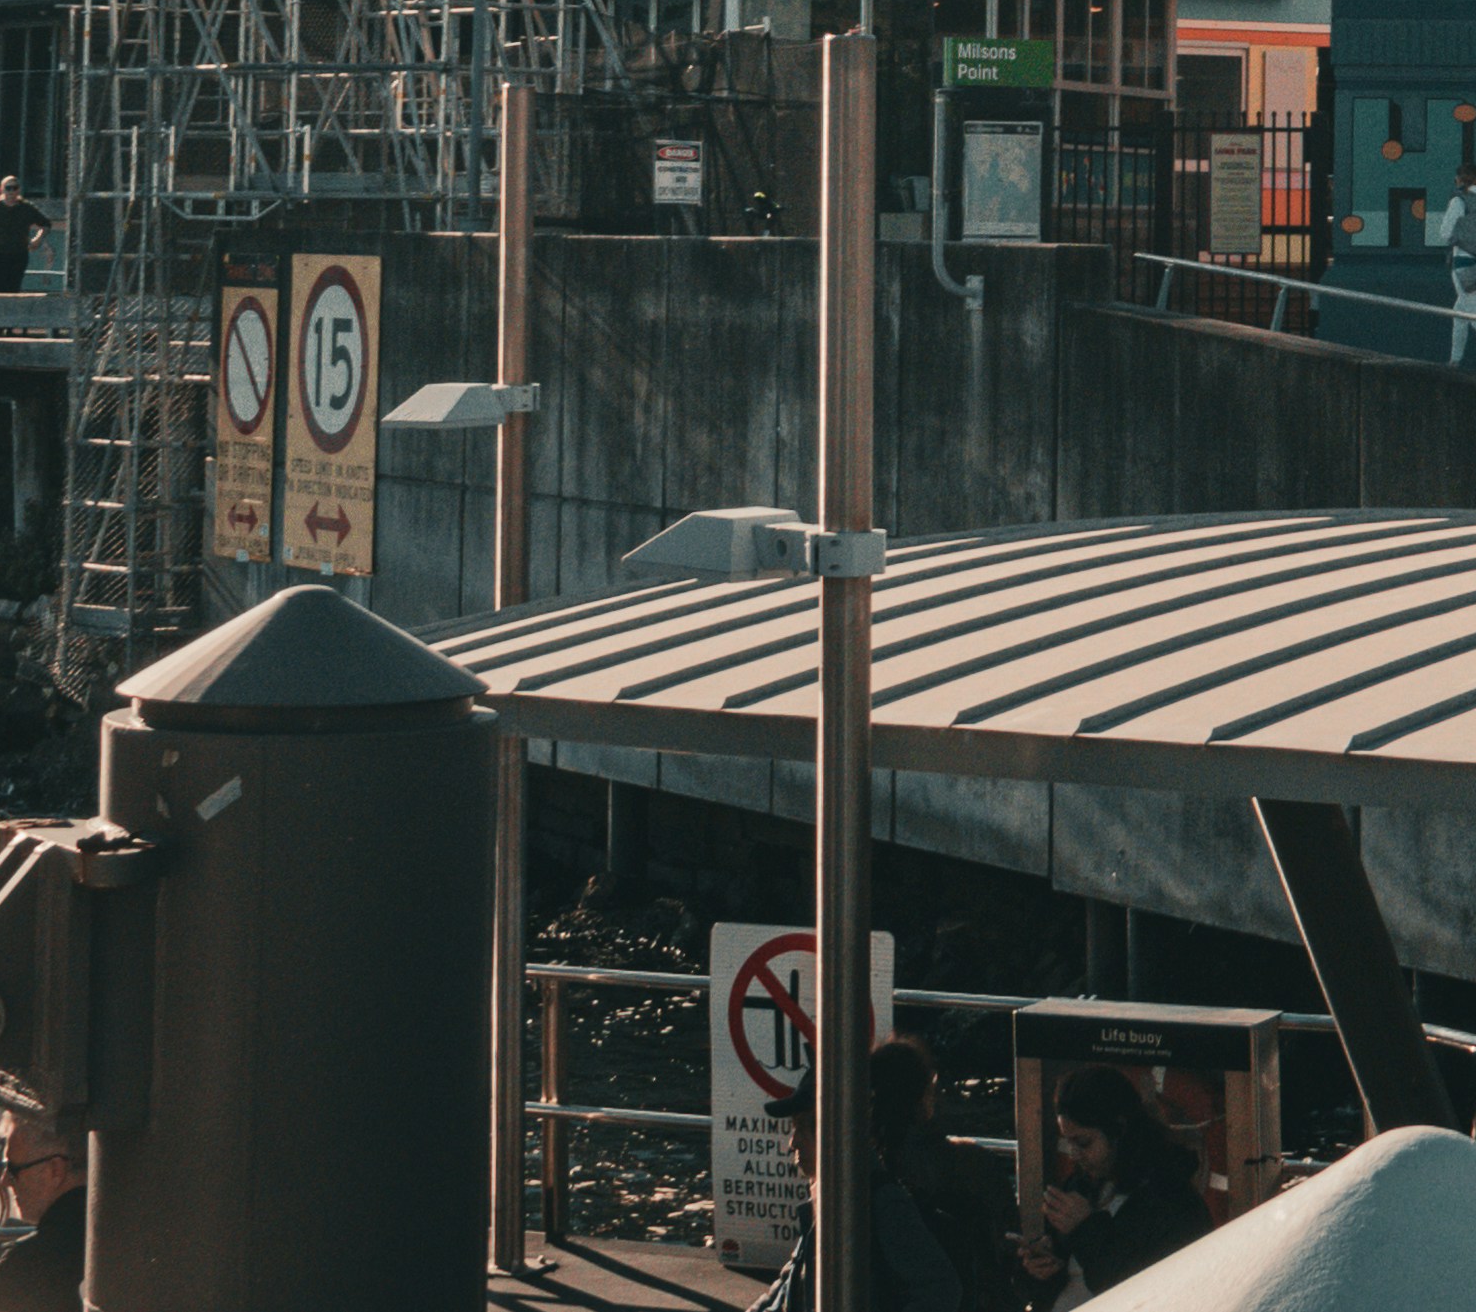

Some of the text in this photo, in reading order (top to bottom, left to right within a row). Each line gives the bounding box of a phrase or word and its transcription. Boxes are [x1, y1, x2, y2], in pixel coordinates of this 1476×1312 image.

[957, 42, 1017, 60] Milsons
[957, 63, 999, 81] Point
[314, 316, 354, 411] 15
[1101, 1027, 1163, 1048] Life buoy
[725, 1114, 793, 1135] MAXIMU
[737, 1137, 797, 1157] DISPLA
[743, 1159, 799, 1178] ALLOW
[723, 1178, 808, 1201] BERTHING
[726, 1199, 799, 1221] STRUCTU
[773, 1224, 802, 1241] TON
